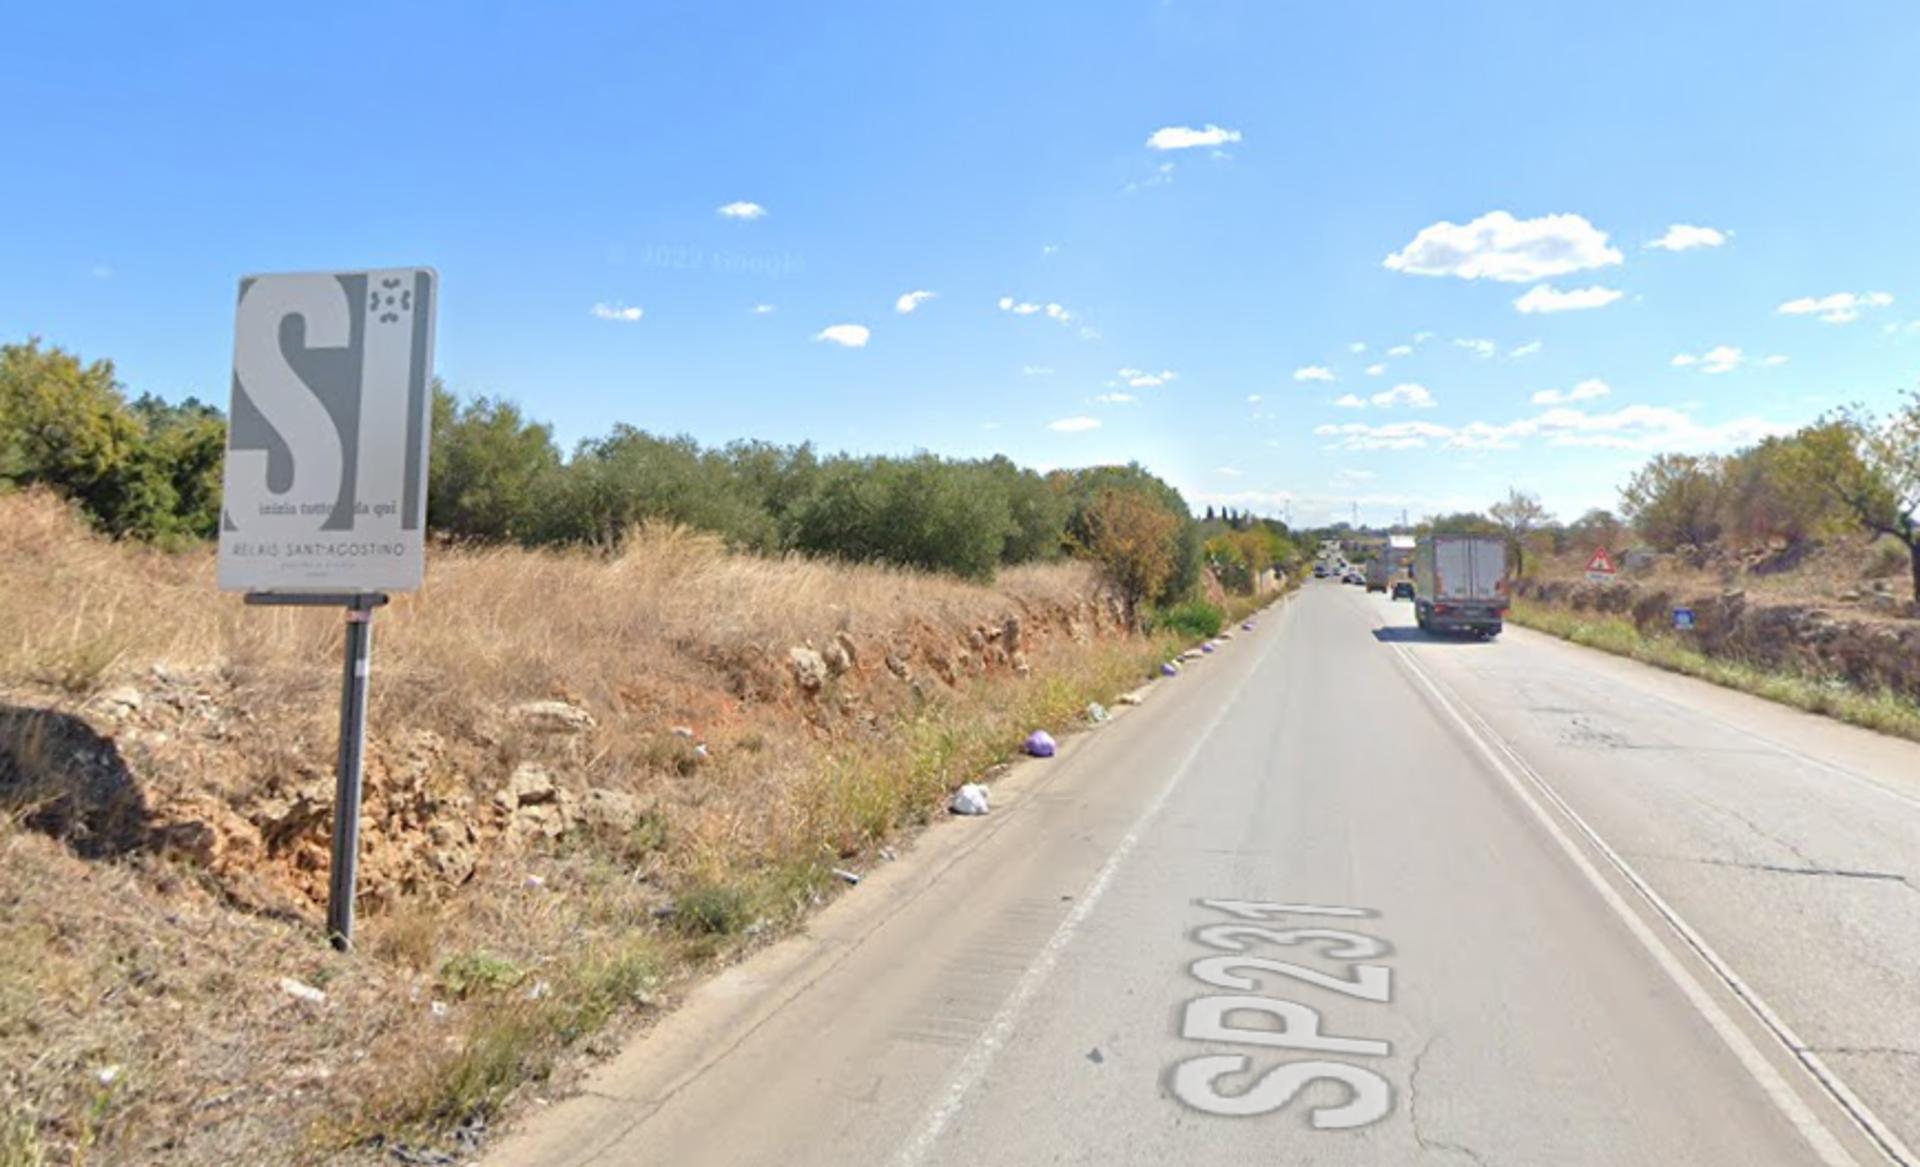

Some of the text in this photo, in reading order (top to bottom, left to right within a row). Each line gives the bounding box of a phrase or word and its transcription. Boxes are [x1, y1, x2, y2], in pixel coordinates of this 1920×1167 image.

[259, 502, 297, 515] inizia
[373, 500, 397, 518] qui
[233, 543, 279, 557] RELAIS
